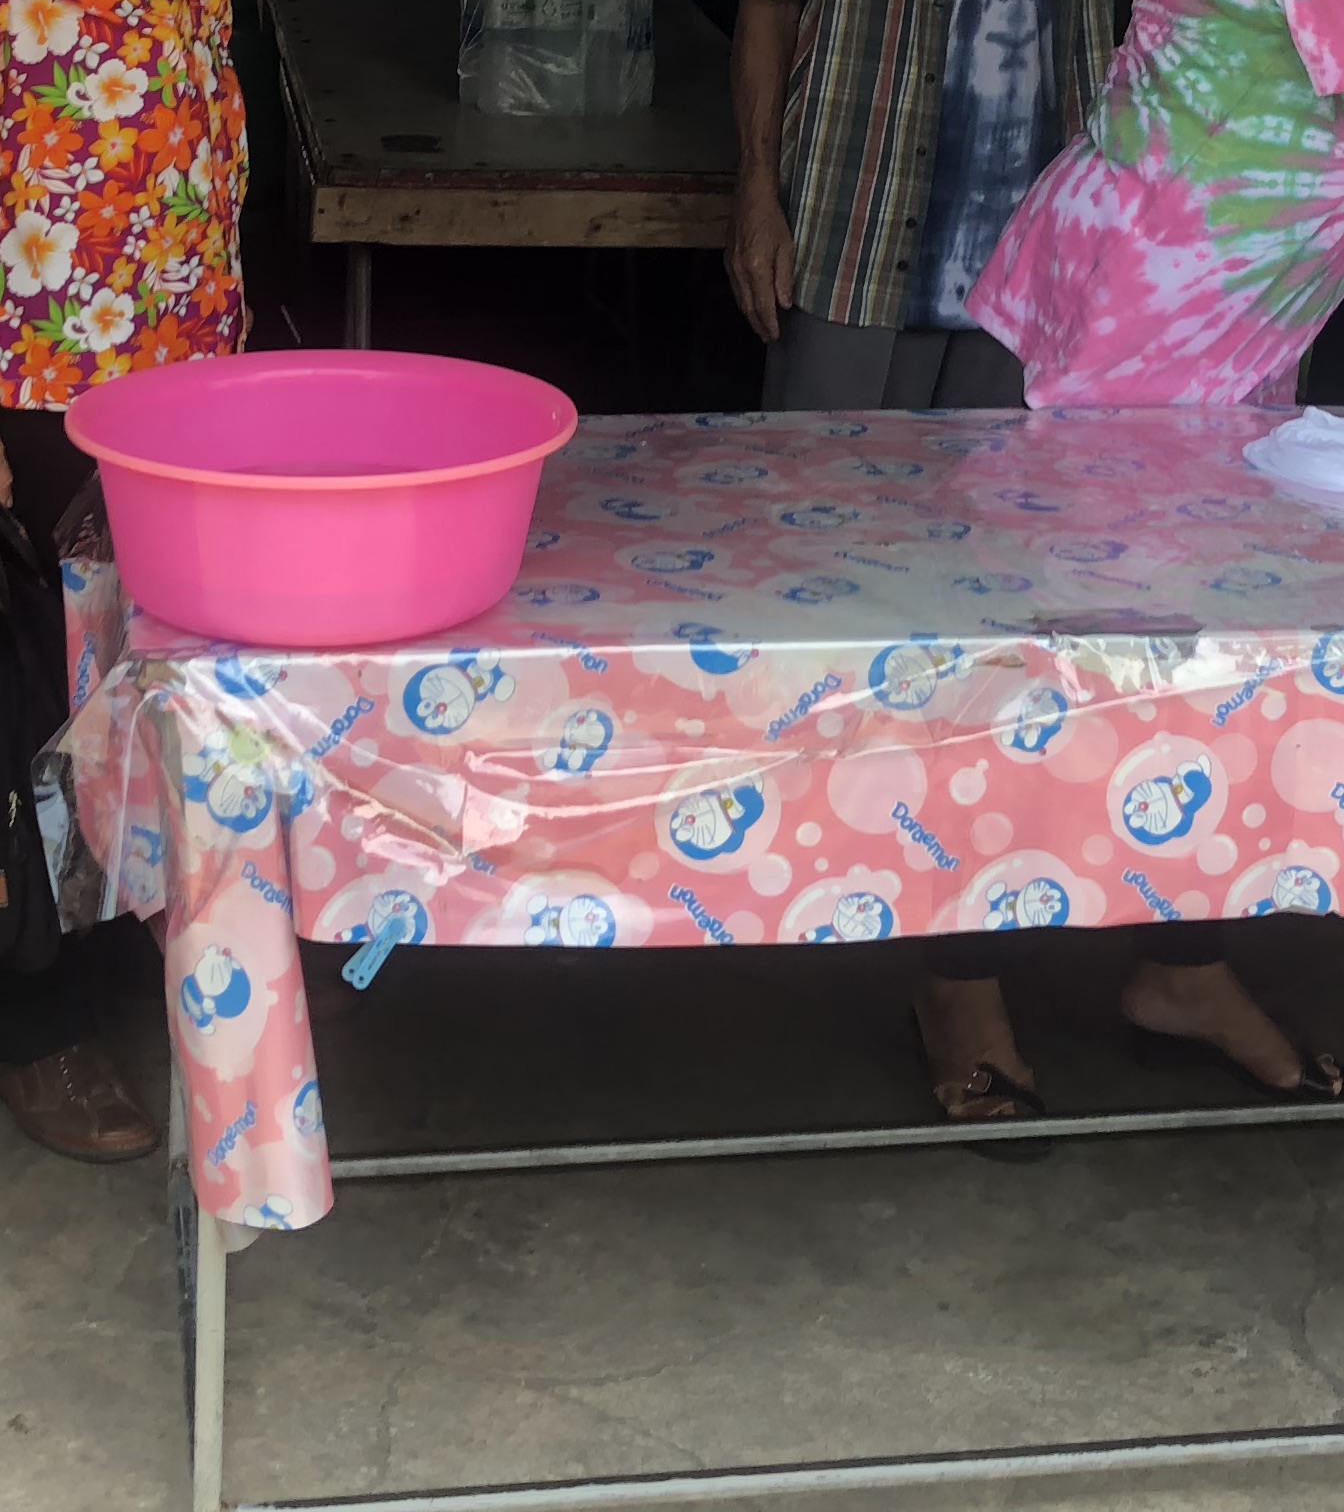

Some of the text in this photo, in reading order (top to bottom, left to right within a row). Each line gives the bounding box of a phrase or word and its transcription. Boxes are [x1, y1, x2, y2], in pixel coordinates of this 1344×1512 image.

[764, 673, 843, 743] Doraemon
[890, 800, 960, 871] Doraemon
[668, 882, 735, 946] oraemon
